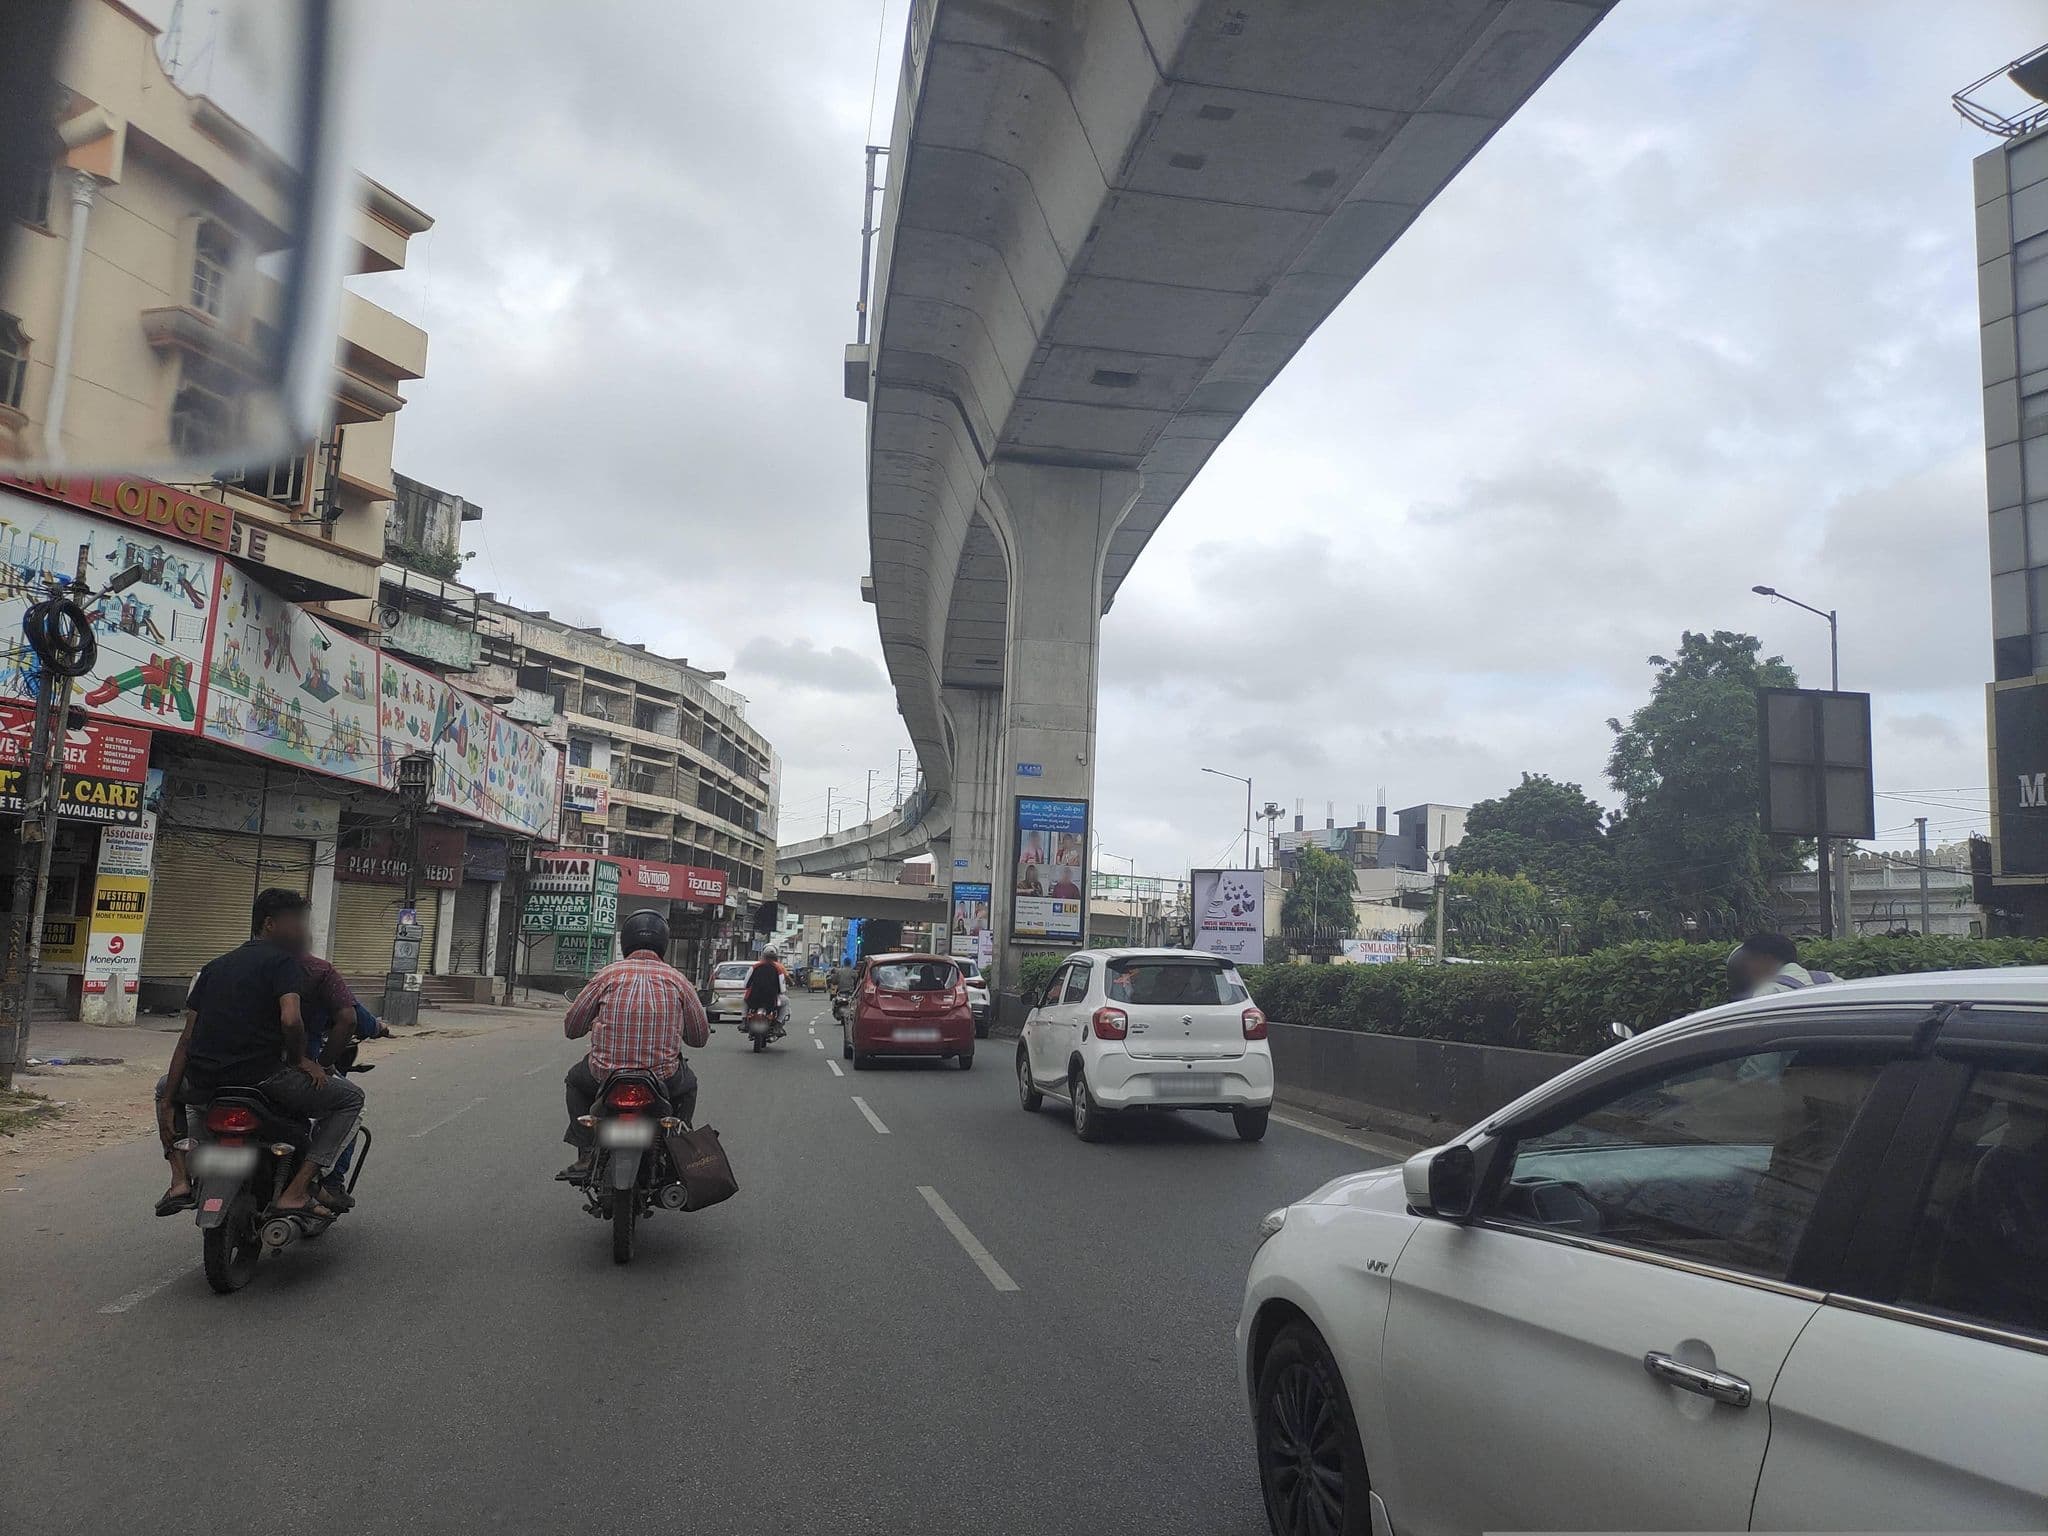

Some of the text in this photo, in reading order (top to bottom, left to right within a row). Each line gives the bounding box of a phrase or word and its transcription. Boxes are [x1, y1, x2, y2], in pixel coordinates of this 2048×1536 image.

[91, 476, 227, 546] LODGE
[75, 780, 140, 808] CARE
[2018, 773, 2048, 808] M
[58, 802, 115, 820] AVAILABLE
[103, 827, 154, 841] Associates
[350, 857, 378, 875] PLAY
[688, 877, 722, 892] TEXTILES
[99, 890, 139, 902] WESTERN
[528, 895, 586, 905] ANWAR
[109, 900, 138, 912] UNION
[542, 905, 588, 913] ACADEMY
[597, 897, 616, 909] IAS
[1064, 903, 1079, 913] LIC
[95, 912, 143, 920] MONEY TRANSFER
[524, 915, 588, 925] IAS IPS
[596, 910, 615, 924] IPS
[1360, 942, 1382, 953] SIMLA
[90, 955, 136, 966] MoneyGram
